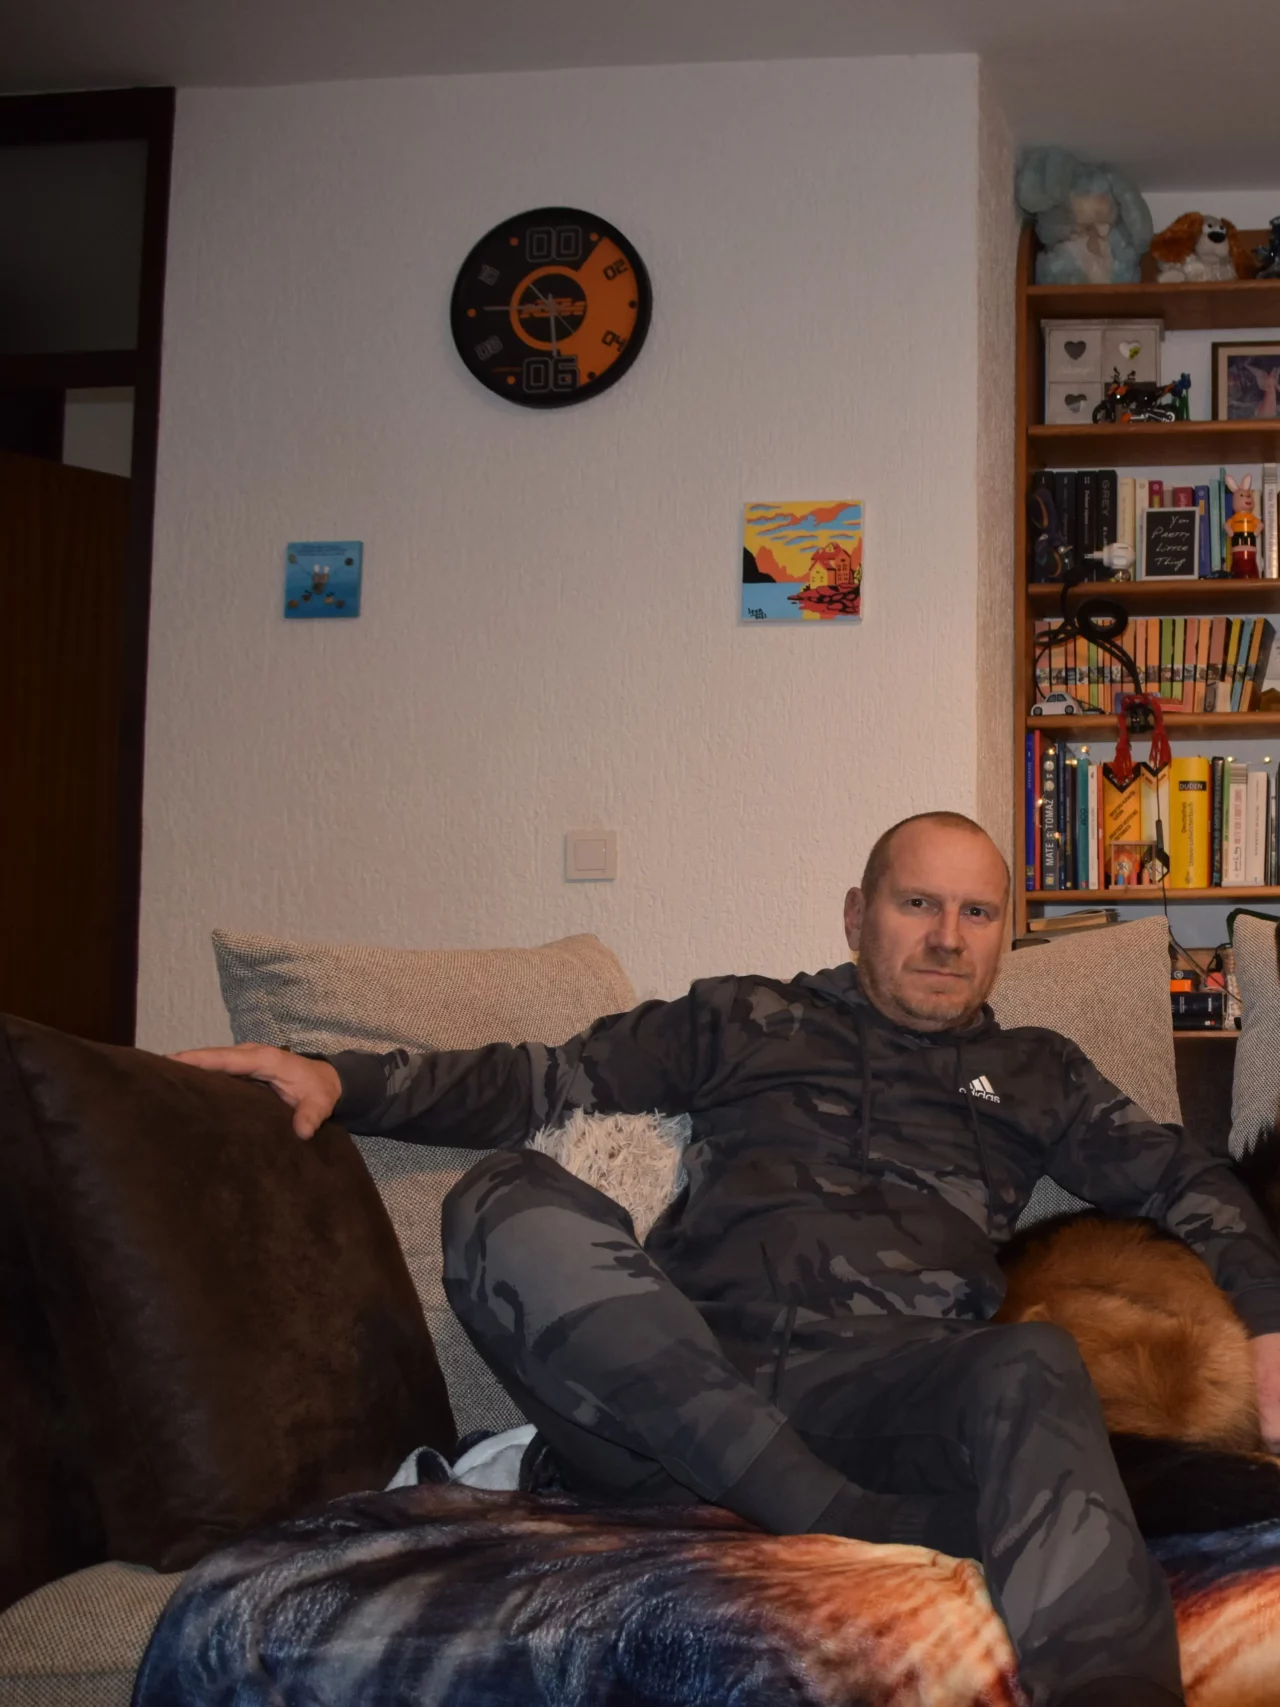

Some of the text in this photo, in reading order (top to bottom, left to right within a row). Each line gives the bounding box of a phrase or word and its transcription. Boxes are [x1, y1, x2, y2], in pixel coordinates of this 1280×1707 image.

[526, 226, 583, 262] 00
[603, 258, 628, 281] 02
[602, 330, 627, 352] 04
[523, 355, 580, 393] 06
[1101, 479, 1111, 517] GREY
[1179, 782, 1203, 791] DUDEN
[1045, 842, 1054, 866] MATE
